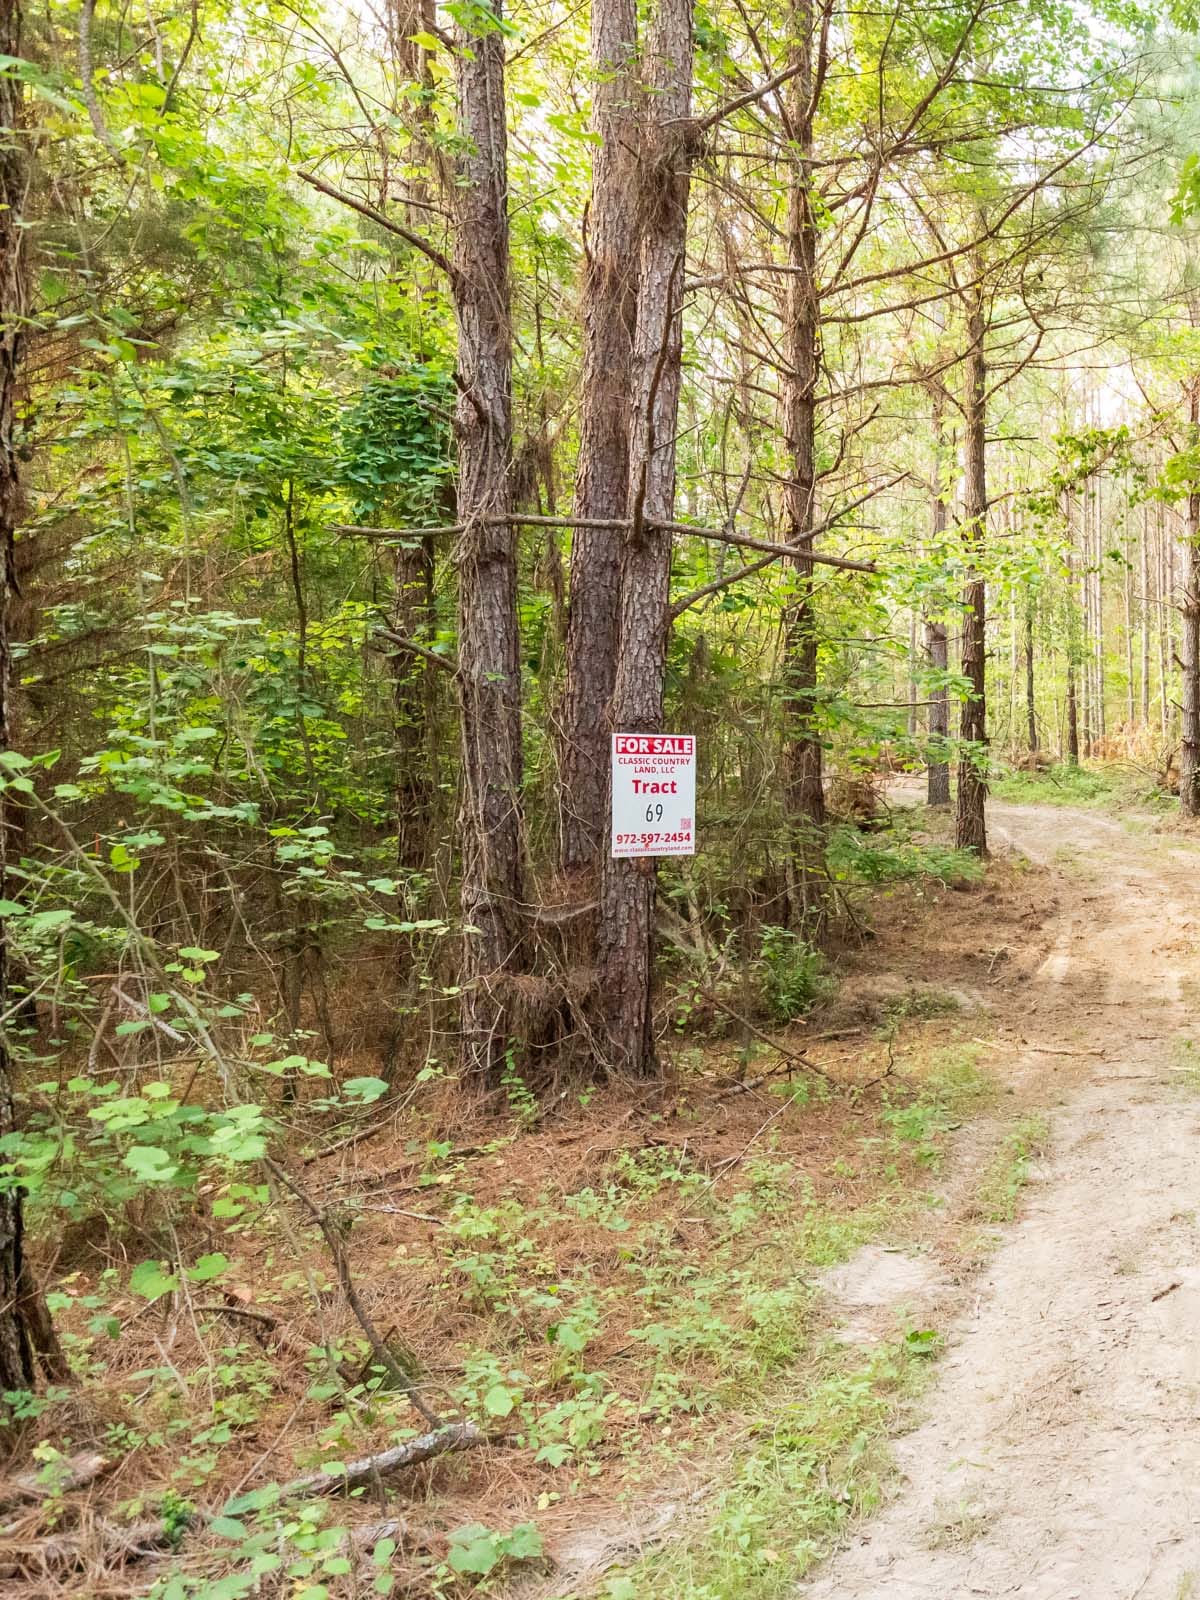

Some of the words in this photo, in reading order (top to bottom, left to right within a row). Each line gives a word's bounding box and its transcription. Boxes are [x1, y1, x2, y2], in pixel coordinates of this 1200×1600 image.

[617, 738, 649, 753] FOR
[653, 739, 691, 753] SALE
[618, 757, 650, 765] CLASSIC
[634, 766, 659, 774] LAND,
[632, 779, 677, 794] Tract
[645, 803, 663, 822] 69
[616, 832, 691, 844] 972-597-2454
